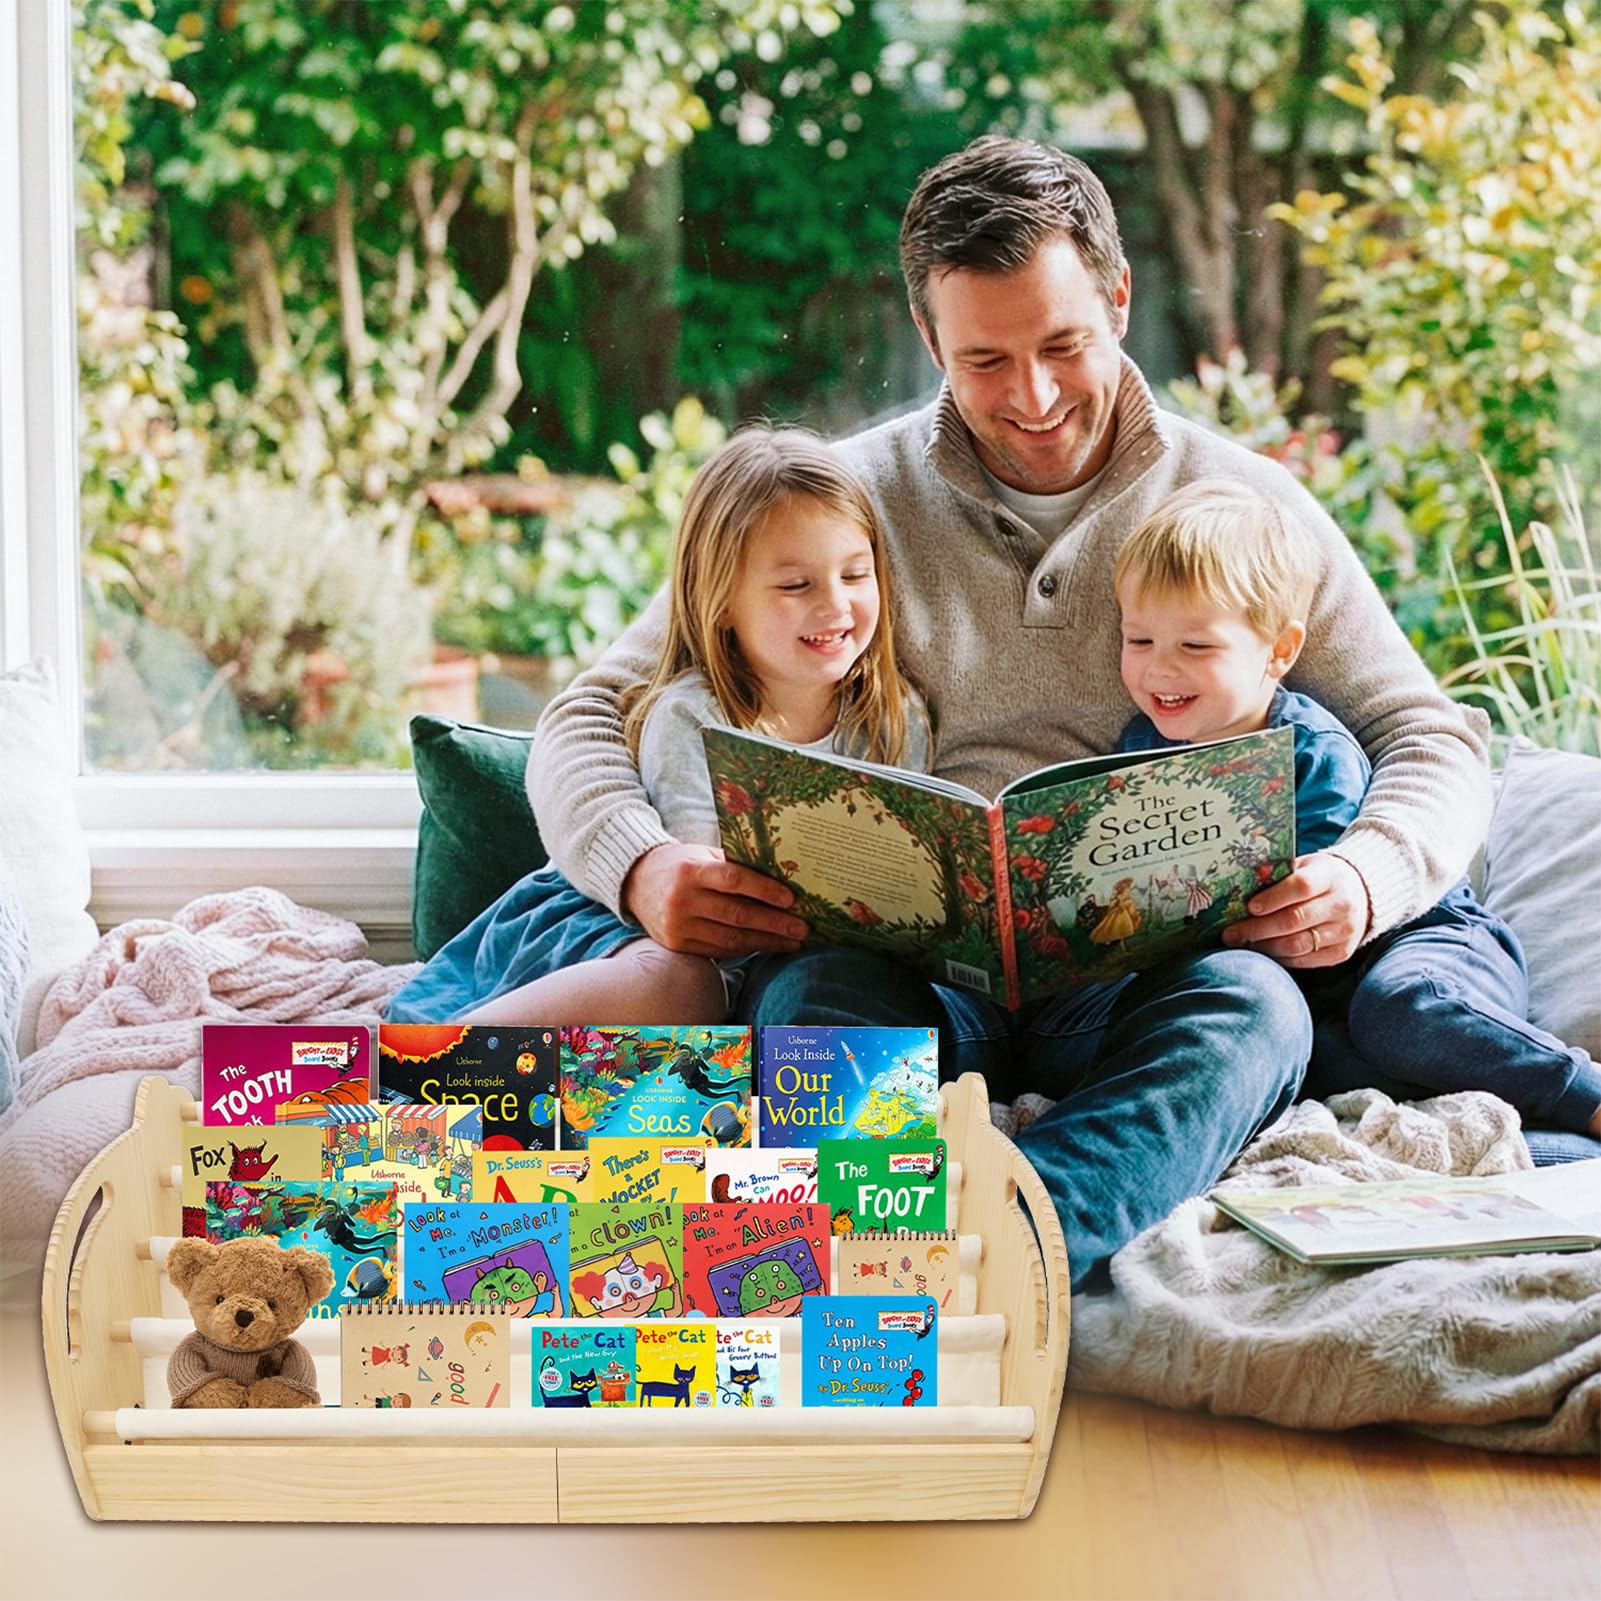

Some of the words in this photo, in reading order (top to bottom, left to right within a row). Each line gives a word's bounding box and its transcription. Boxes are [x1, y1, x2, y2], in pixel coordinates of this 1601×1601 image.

[1134, 794, 1176, 811] The
[1099, 799, 1214, 841] Secret
[1088, 824, 1222, 867] Garden
[787, 1035, 817, 1045] Usborne
[456, 1057, 482, 1066] Usborne
[774, 1047, 801, 1061] Look
[803, 1048, 836, 1061] Inside
[219, 1064, 247, 1082] The
[446, 1073, 471, 1088] Look
[474, 1075, 505, 1087] inside
[775, 1065, 832, 1095] Our
[211, 1069, 292, 1124] TOOTH
[632, 1095, 656, 1104] LOOK
[659, 1095, 687, 1104] INSIDE
[627, 1104, 691, 1133] Seas
[762, 1094, 846, 1126] World
[486, 1161, 504, 1174] Dr.
[505, 1156, 543, 1170] Seuss's
[602, 1149, 649, 1176] There's
[835, 1161, 868, 1180] The
[371, 1169, 406, 1179] Usborne
[624, 1173, 633, 1182] a
[734, 1180, 749, 1190] Mr.
[749, 1173, 779, 1186] Brown
[396, 1182, 422, 1193] side
[753, 1185, 770, 1195] Can
[858, 1184, 936, 1219] FOOT
[408, 1207, 446, 1233] Look
[450, 1210, 460, 1219] at
[569, 1208, 579, 1217] at
[713, 1209, 724, 1218] at
[437, 1246, 457, 1259] I'm
[705, 1245, 723, 1258] I'm
[726, 1242, 737, 1250] an
[822, 1311, 855, 1328] Ten
[542, 1330, 579, 1349] Pete
[594, 1332, 625, 1349] Cat
[636, 1329, 667, 1343] Pete
[678, 1329, 706, 1343] Cat
[716, 1329, 732, 1344] te
[744, 1329, 772, 1344] Cat
[827, 1331, 888, 1352] Apples
[818, 1355, 842, 1373] Up
[847, 1356, 873, 1372] On
[877, 1353, 914, 1372] Top!
[448, 1361, 470, 1405] good
[829, 1379, 850, 1395] Dr.
